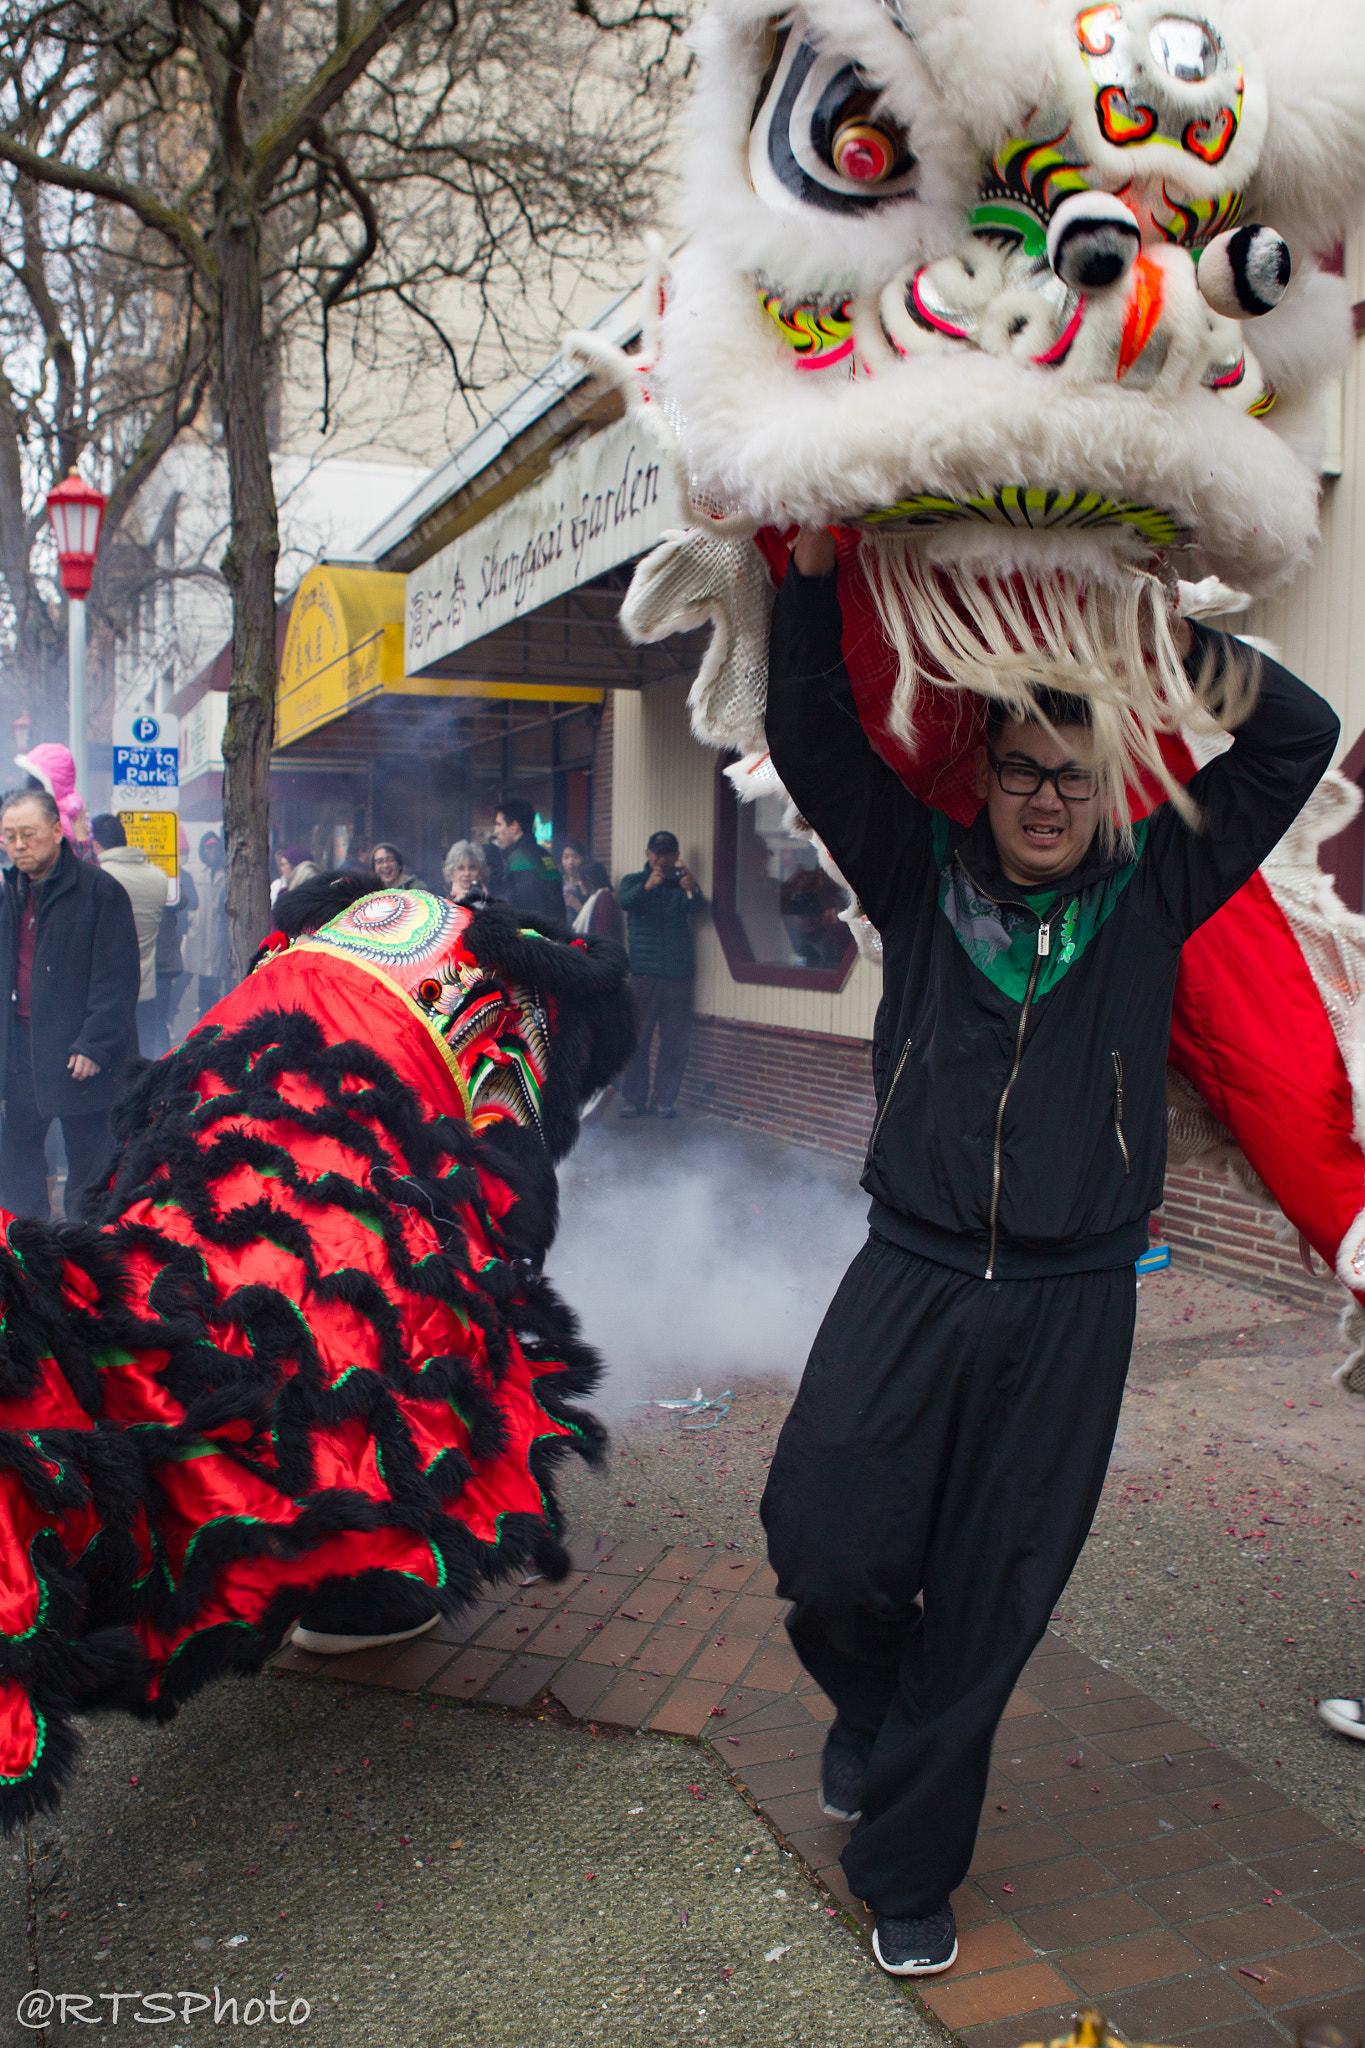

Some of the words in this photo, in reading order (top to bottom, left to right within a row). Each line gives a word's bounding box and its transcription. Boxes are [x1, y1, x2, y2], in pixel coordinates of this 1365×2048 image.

[571, 445, 659, 577] Garden
[117, 750, 149, 768] Pay
[156, 750, 175, 766] to
[127, 767, 167, 782] Park
[120, 812, 132, 824] 30
[139, 815, 166, 823] MNUTE
